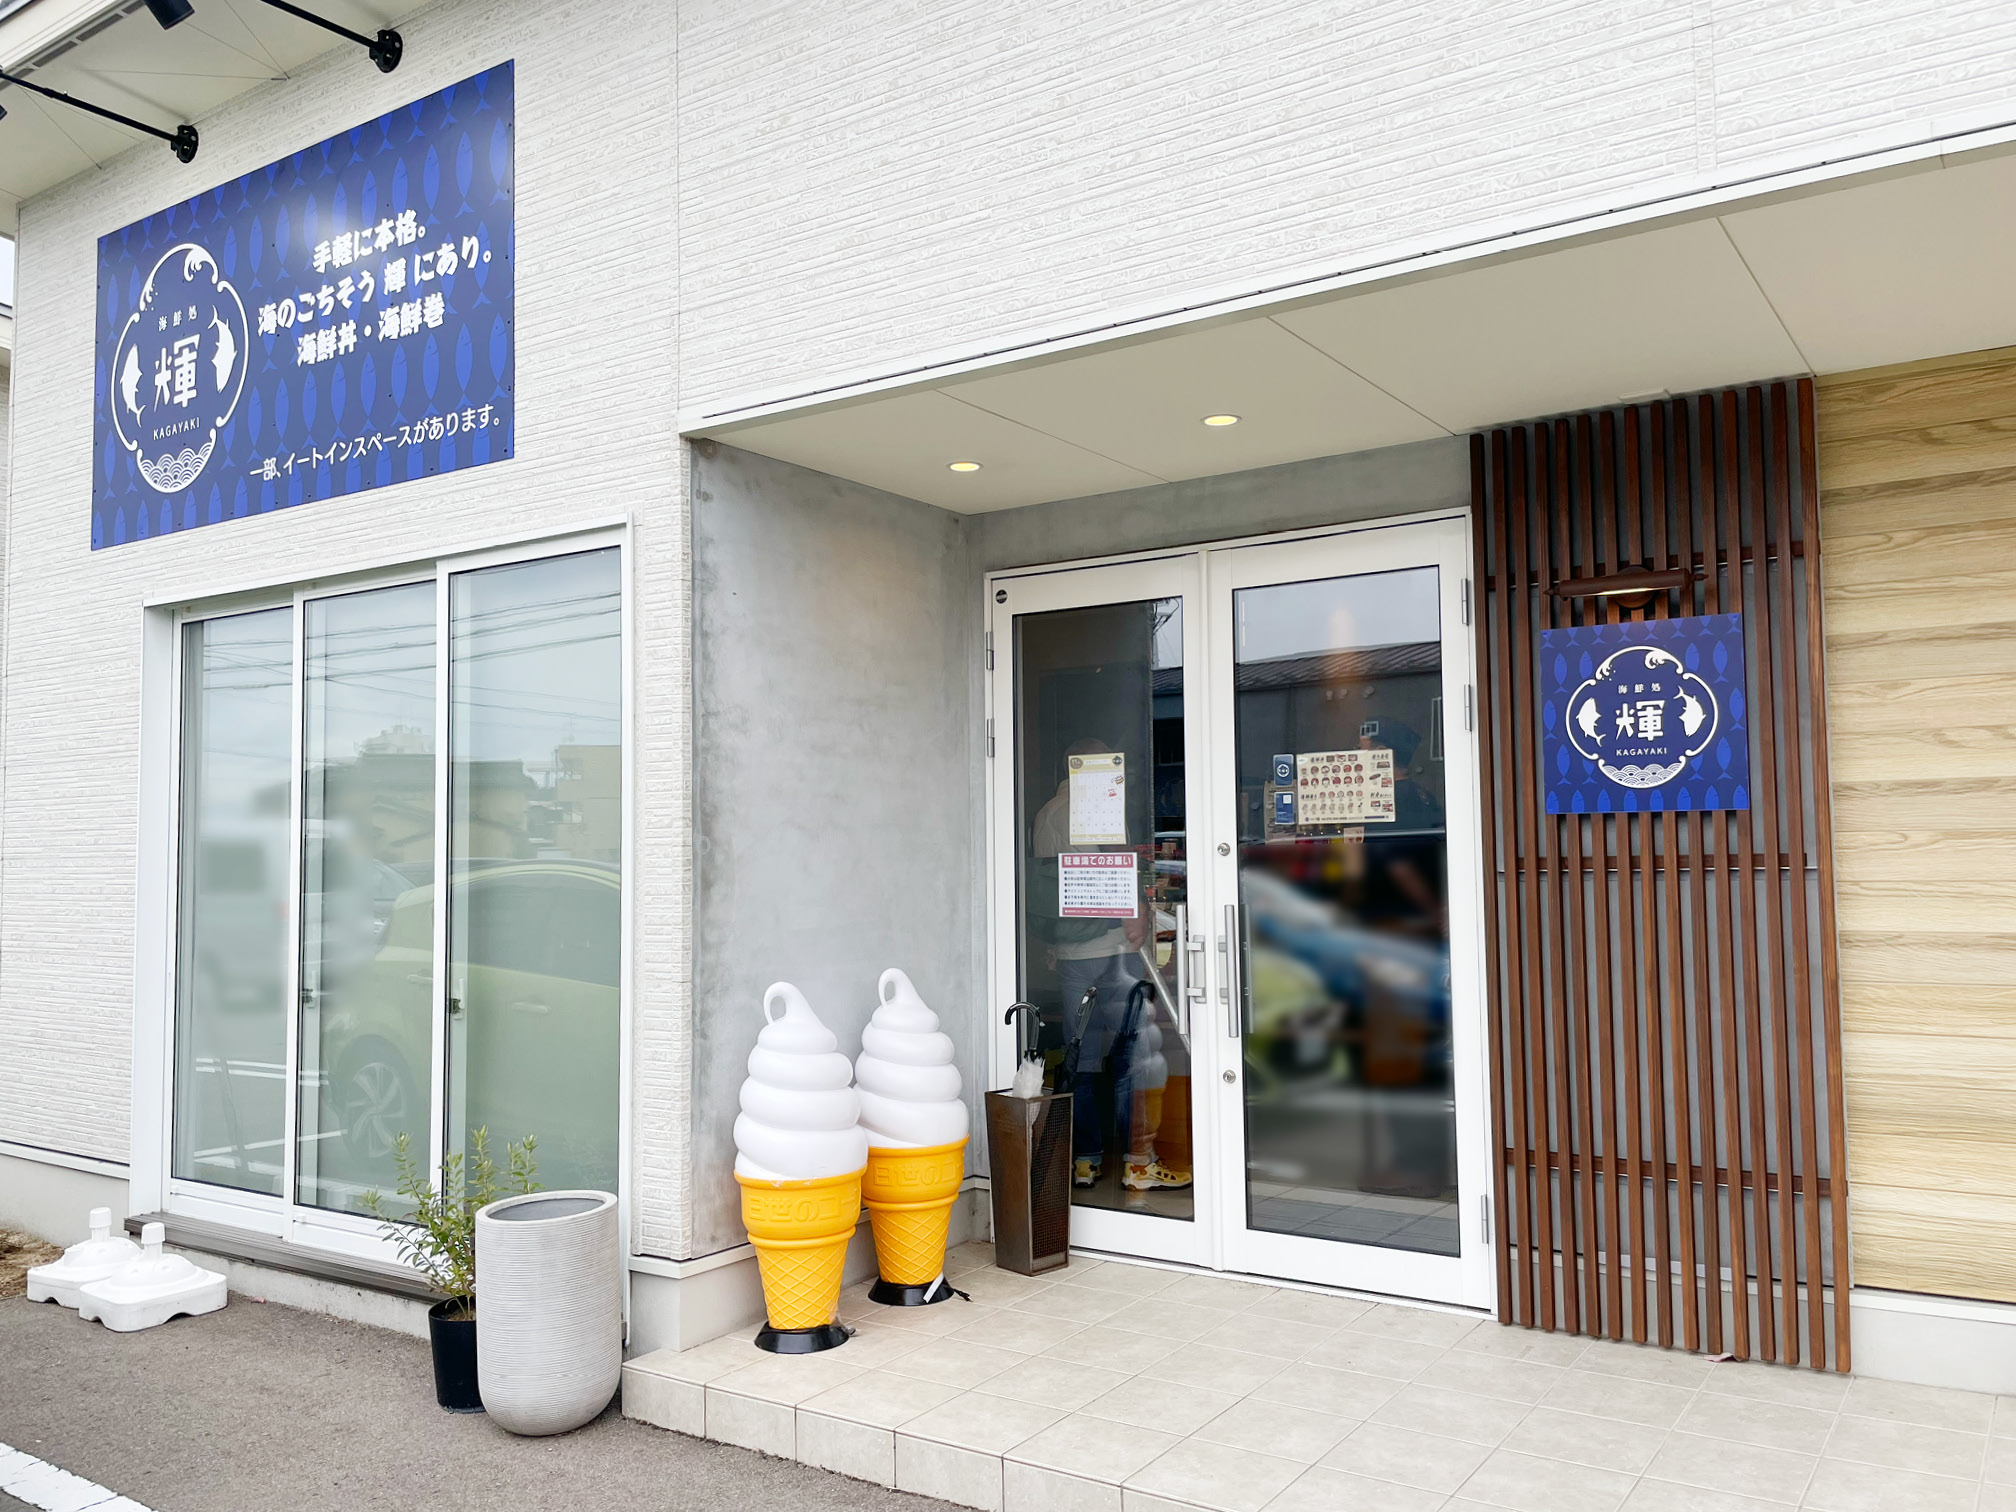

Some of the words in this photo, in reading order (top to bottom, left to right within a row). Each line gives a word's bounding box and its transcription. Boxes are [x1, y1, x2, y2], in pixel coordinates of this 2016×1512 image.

[312, 209, 426, 273] 手軽に本格。
[257, 269, 375, 336] 海のごちそう
[383, 257, 407, 296] 輝
[413, 235, 492, 286] にあり。
[158, 304, 198, 332] 海鮮処
[297, 292, 446, 368] 海鮮丼・海鮮巻
[153, 333, 200, 413] 輝
[153, 416, 200, 441] KAGAYAKI
[249, 403, 501, 481] 一部、イートインスペースがあります。
[1618, 683, 1660, 693] 海鮮処
[1616, 700, 1665, 741] 輝
[1616, 747, 1667, 756] KAGAYAKI
[1064, 856, 1131, 865] 駐車場でのお願い
